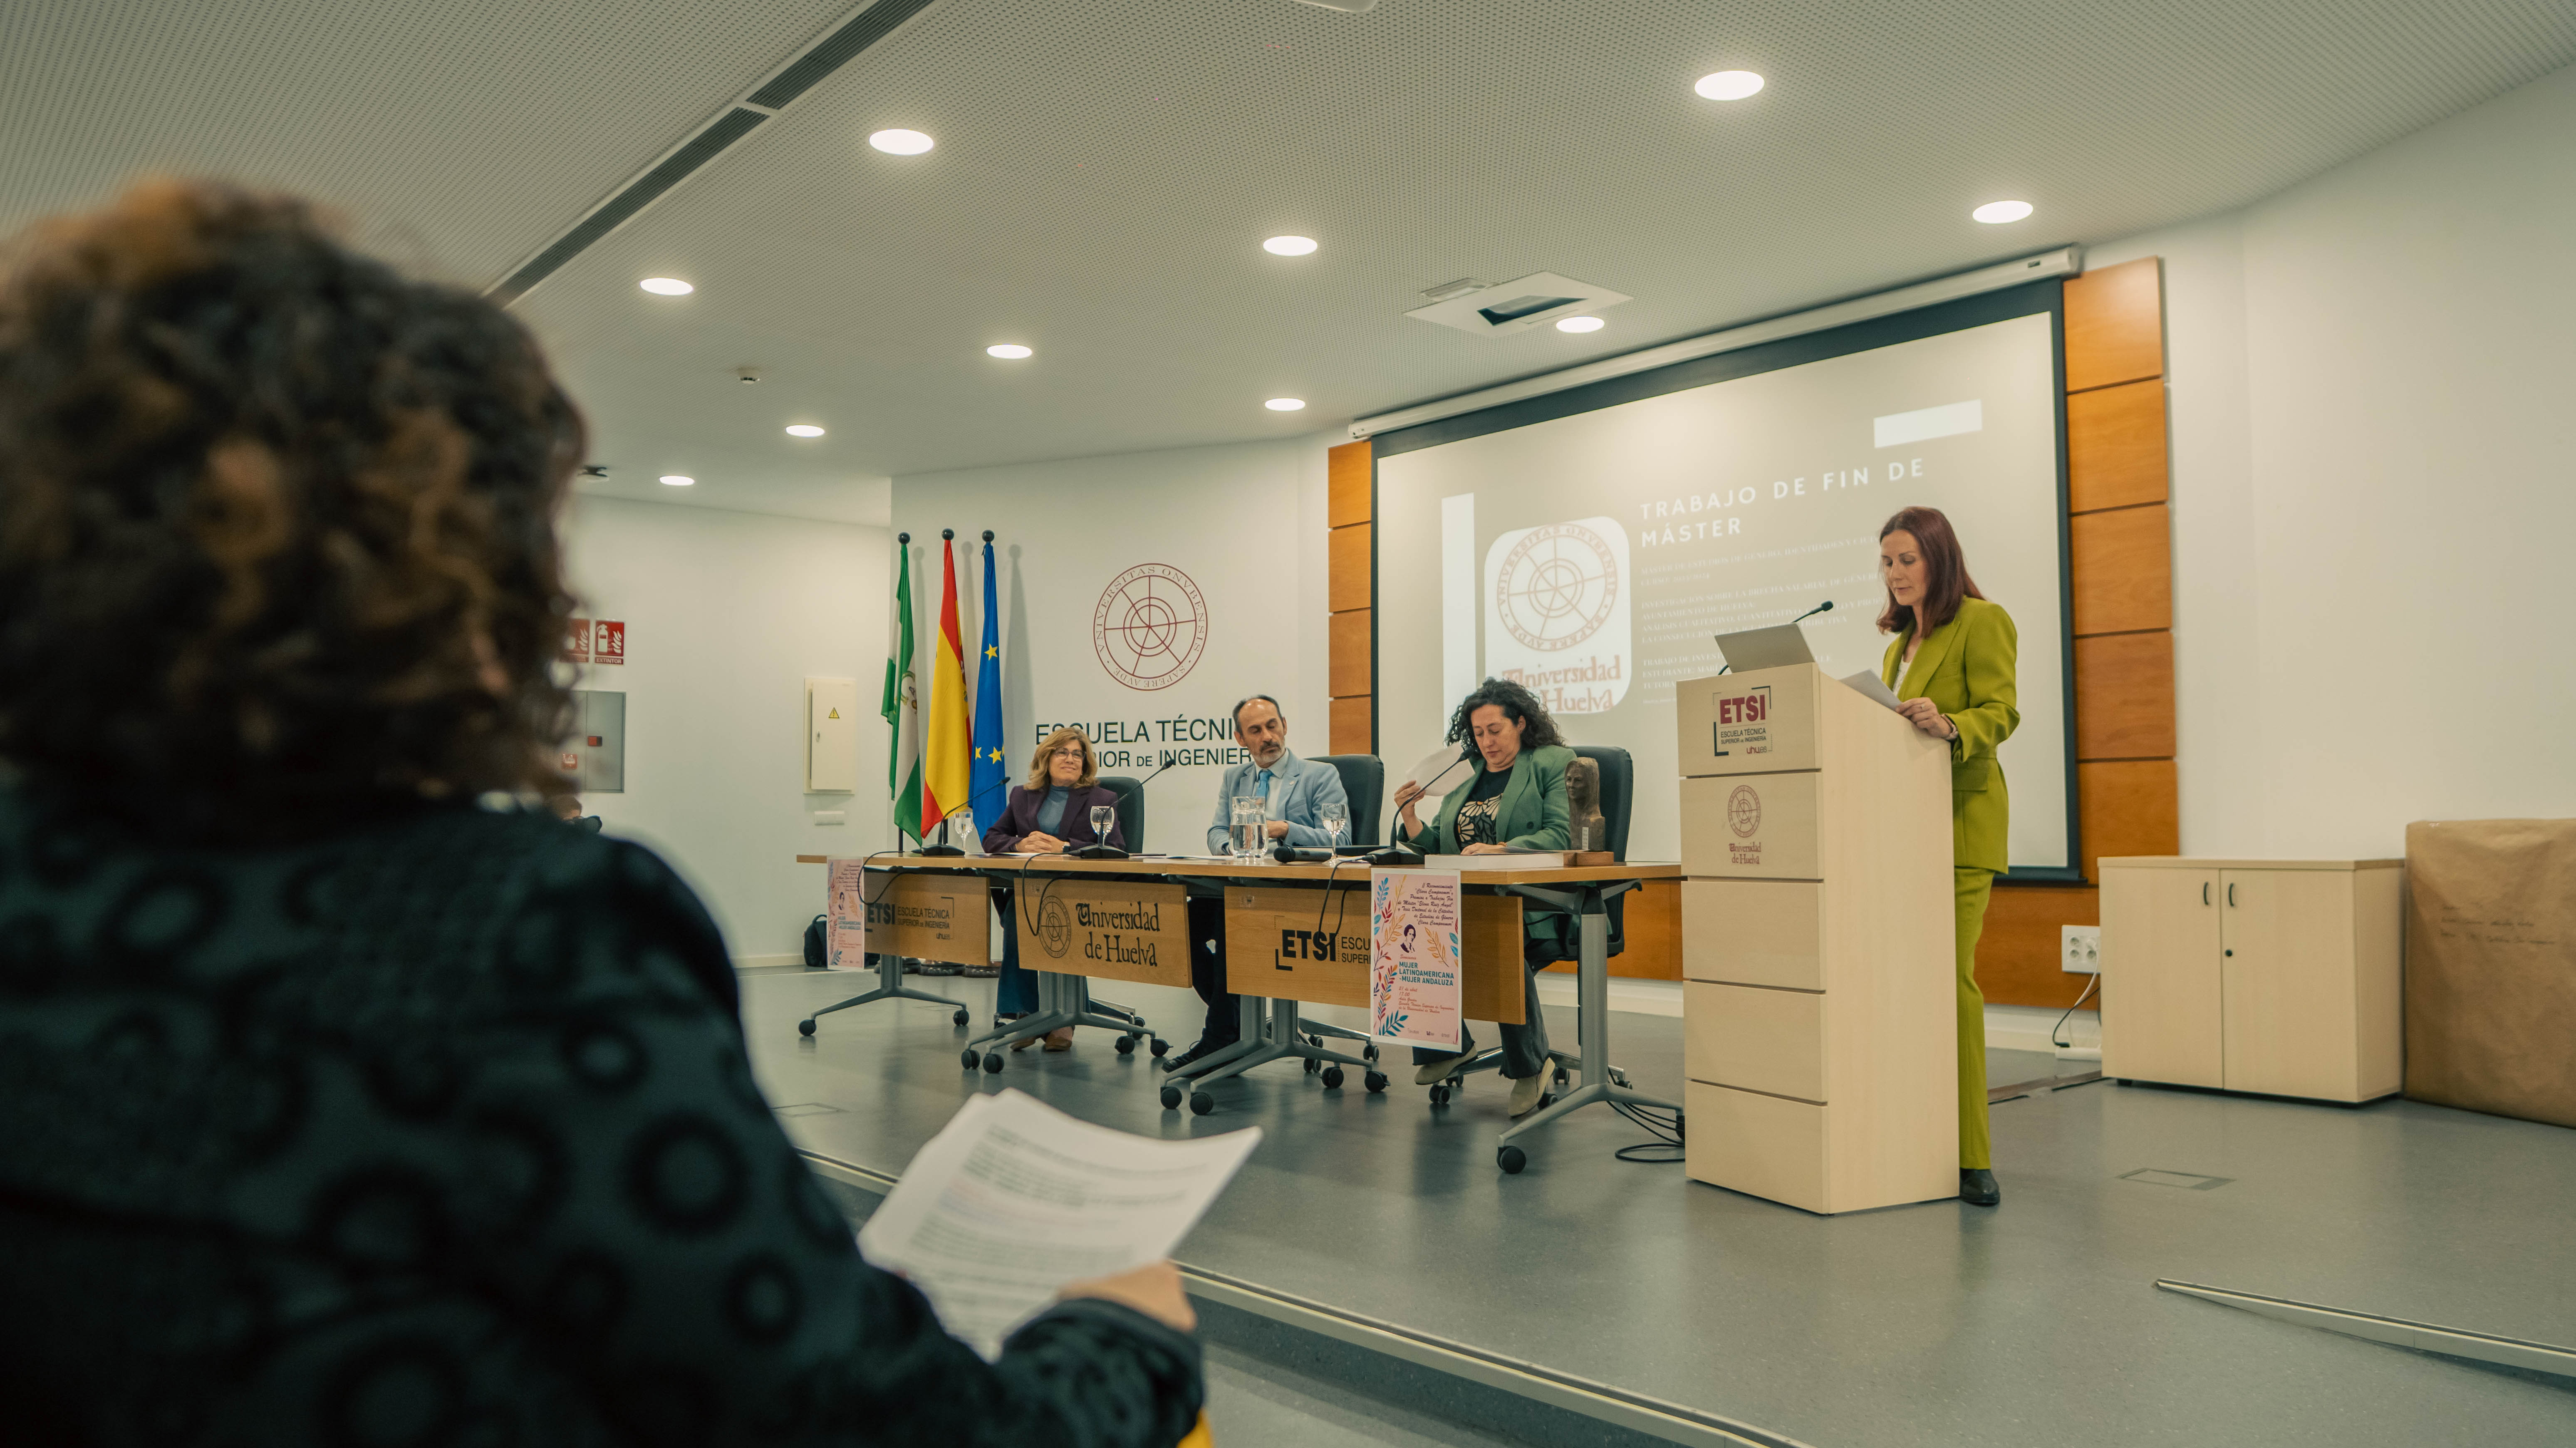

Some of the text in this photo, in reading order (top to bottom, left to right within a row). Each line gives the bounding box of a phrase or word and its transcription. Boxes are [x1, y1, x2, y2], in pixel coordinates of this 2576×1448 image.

[1640, 458, 1923, 520] TRABAJO DE FIN DE
[1641, 517, 1741, 548] MÁSTER
[1095, 566, 1205, 653] VNIVERSITAS ONVBENSIS
[1113, 665, 1186, 688] SAPERE AVDE
[1502, 655, 1621, 688] Universidad
[1720, 694, 1766, 724] ETSI
[1035, 721, 1150, 745] EUELA
[1744, 727, 1766, 736] TÉCNICA
[1136, 756, 1153, 767] DE
[1729, 842, 1761, 853] Universidad
[1731, 853, 1760, 864] de Huelva
[867, 902, 896, 925] ETSI
[897, 906, 950, 919] ESCUELA TÉCNICA
[897, 918, 919, 927] SUPERIOR
[1075, 901, 1160, 932] Universidad
[1085, 931, 1158, 967] de Huelva
[1282, 929, 1336, 962] ETSI
[1341, 936, 1371, 951] ESCU
[1399, 968, 1454, 979] LATINOAMERICANA
[1422, 977, 1453, 987] ANDALUZA
